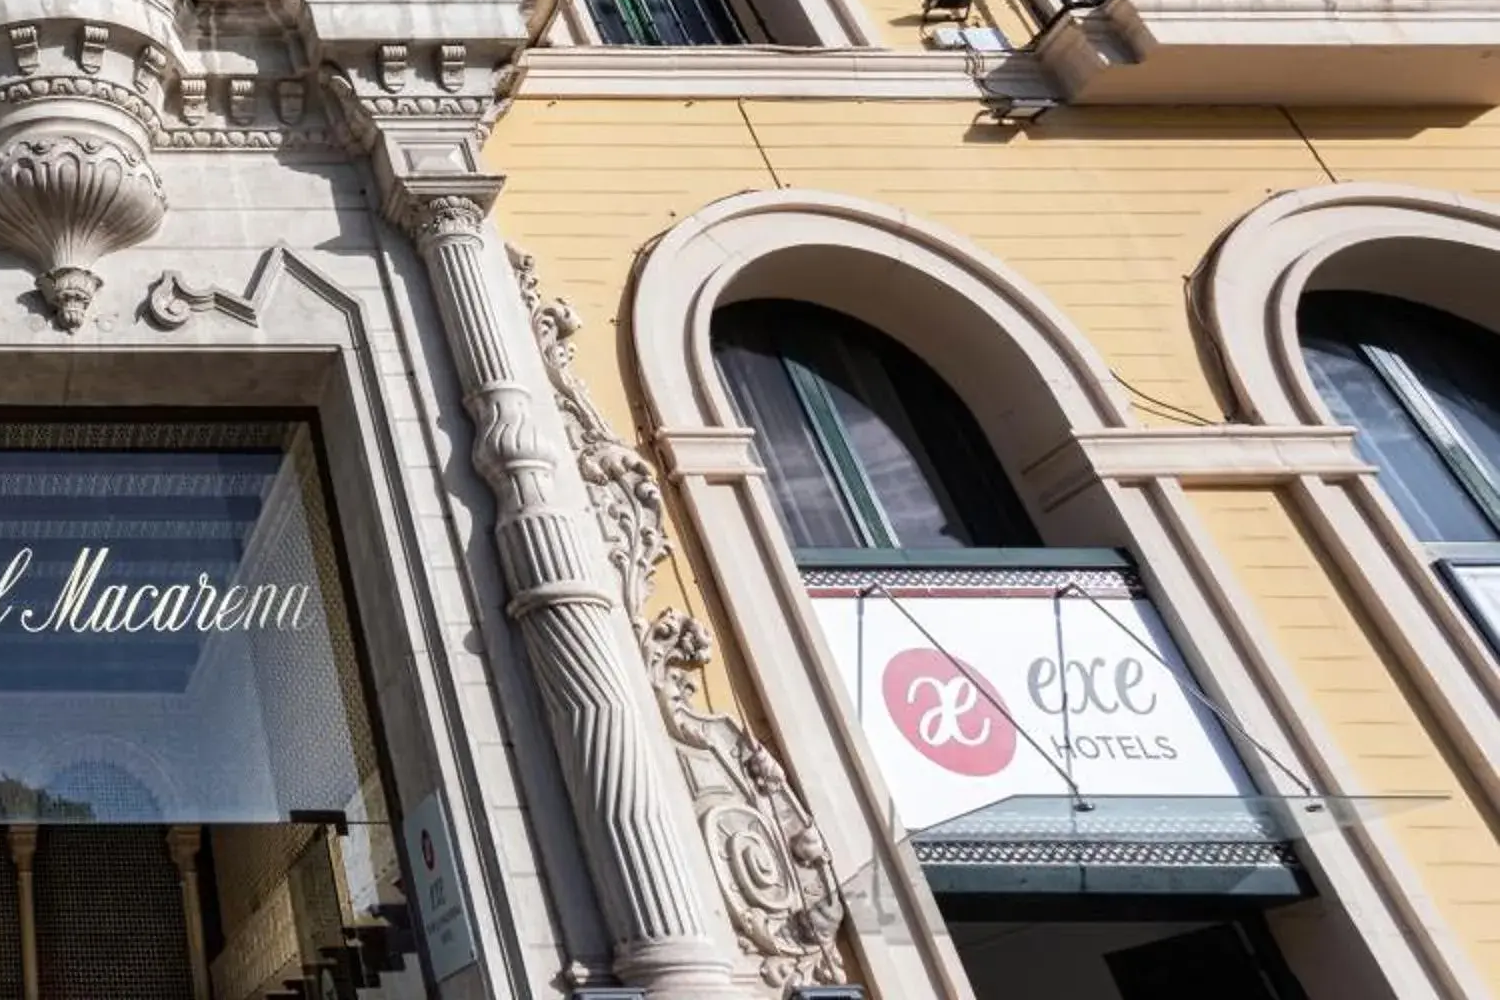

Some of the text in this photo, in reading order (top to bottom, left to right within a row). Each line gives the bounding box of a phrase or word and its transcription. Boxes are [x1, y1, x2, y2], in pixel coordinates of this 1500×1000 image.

[20, 546, 315, 634] Macarena
[1026, 656, 1158, 715] exe
[1050, 734, 1179, 760] HOTELS
